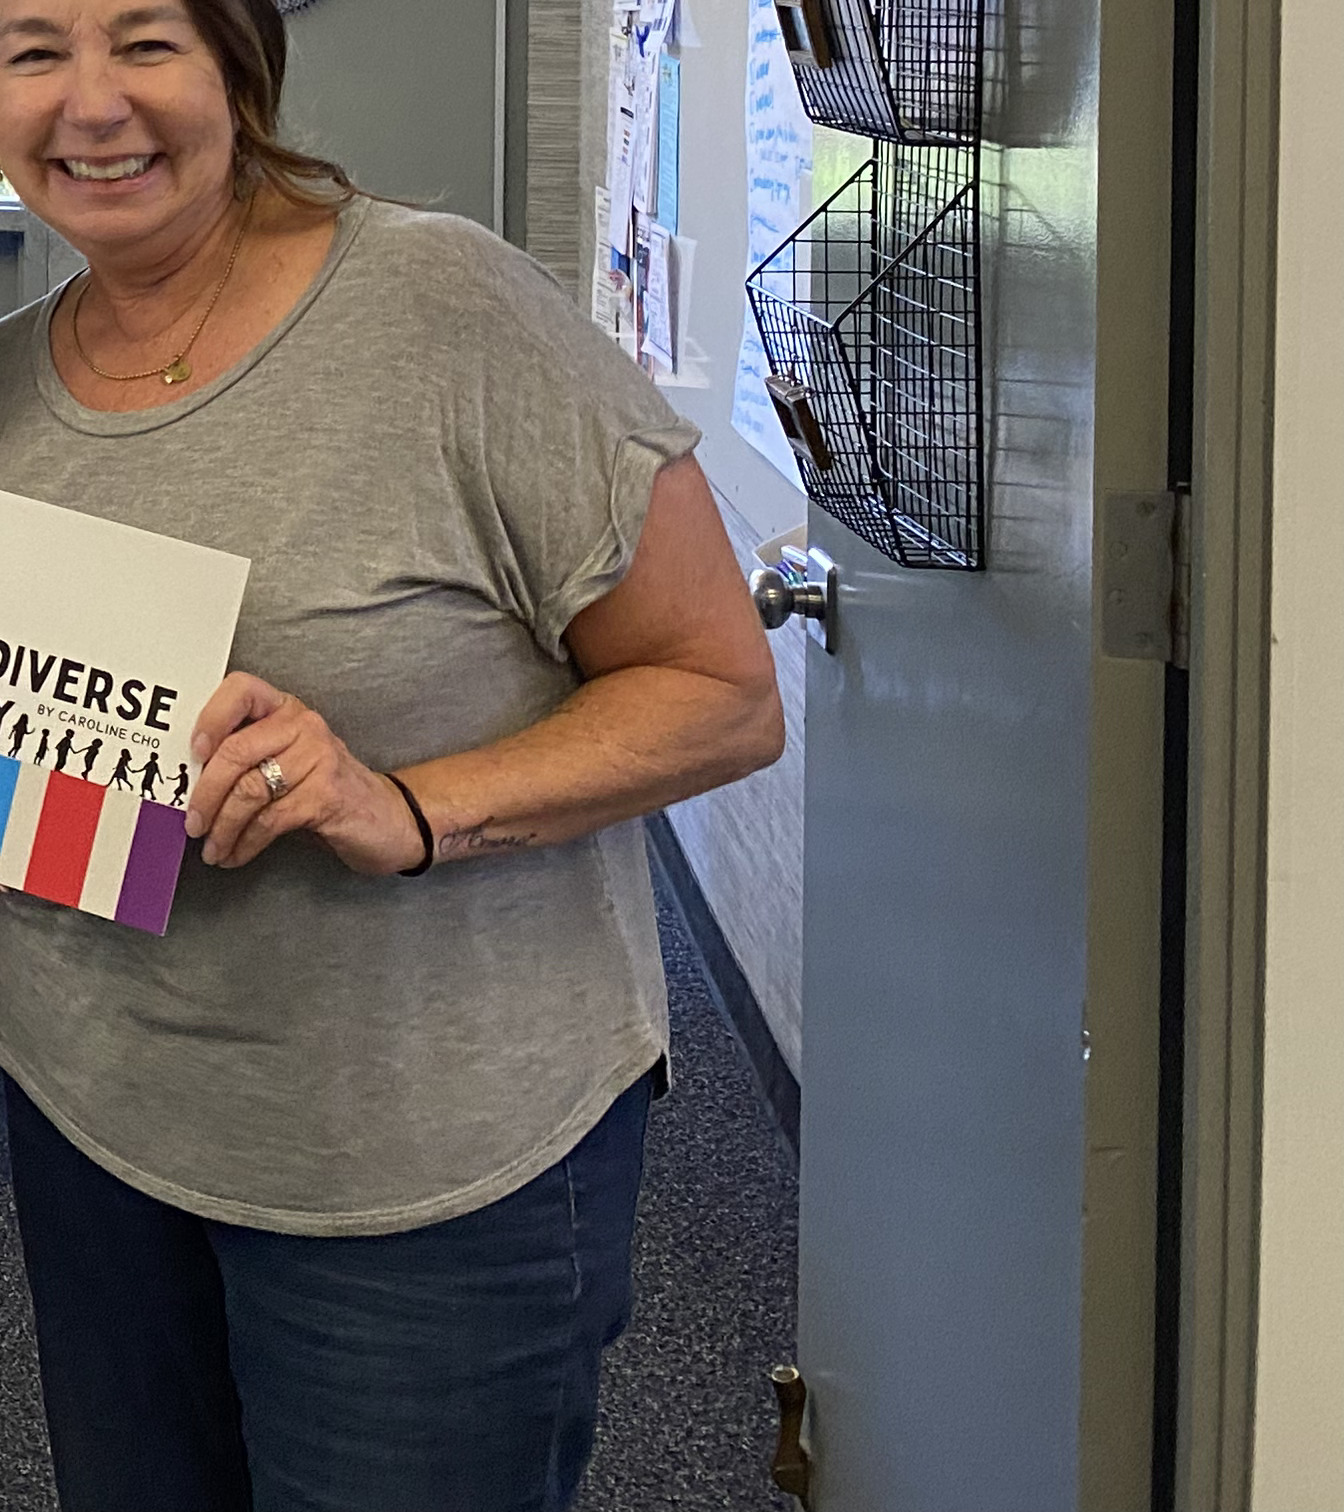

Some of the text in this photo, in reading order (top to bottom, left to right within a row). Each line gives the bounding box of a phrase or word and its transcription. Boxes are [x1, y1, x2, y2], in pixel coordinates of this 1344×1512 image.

[37, 704, 161, 750] BY CAROLINE CHO
